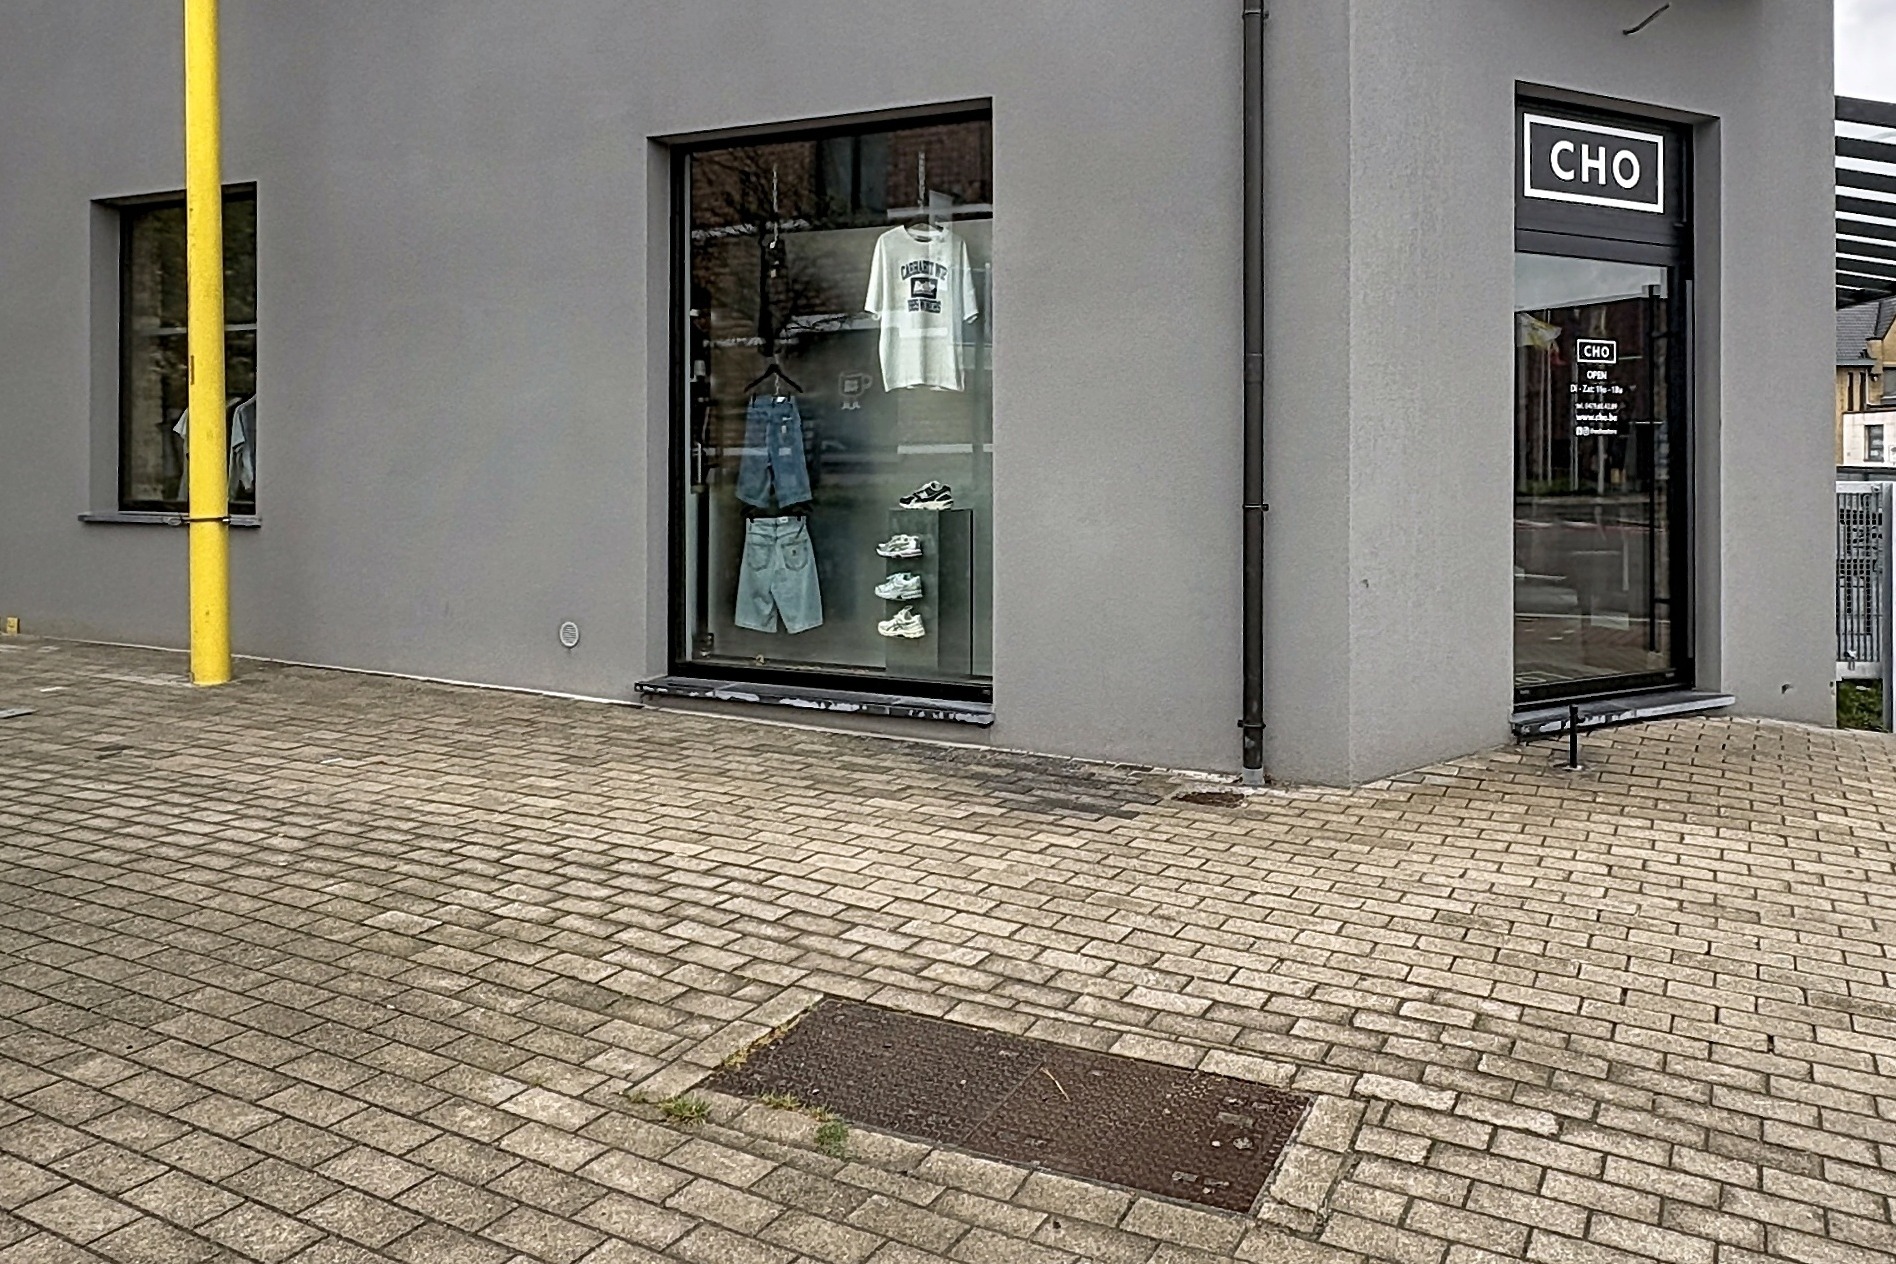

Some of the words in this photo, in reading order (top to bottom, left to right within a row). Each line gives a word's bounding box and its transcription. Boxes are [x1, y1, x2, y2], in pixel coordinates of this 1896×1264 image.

[1551, 140, 1640, 189] CHO
[1583, 345, 1610, 358] CHO
[1586, 370, 1608, 380] OPEN
[1576, 412, 1618, 422] www.cho.be
